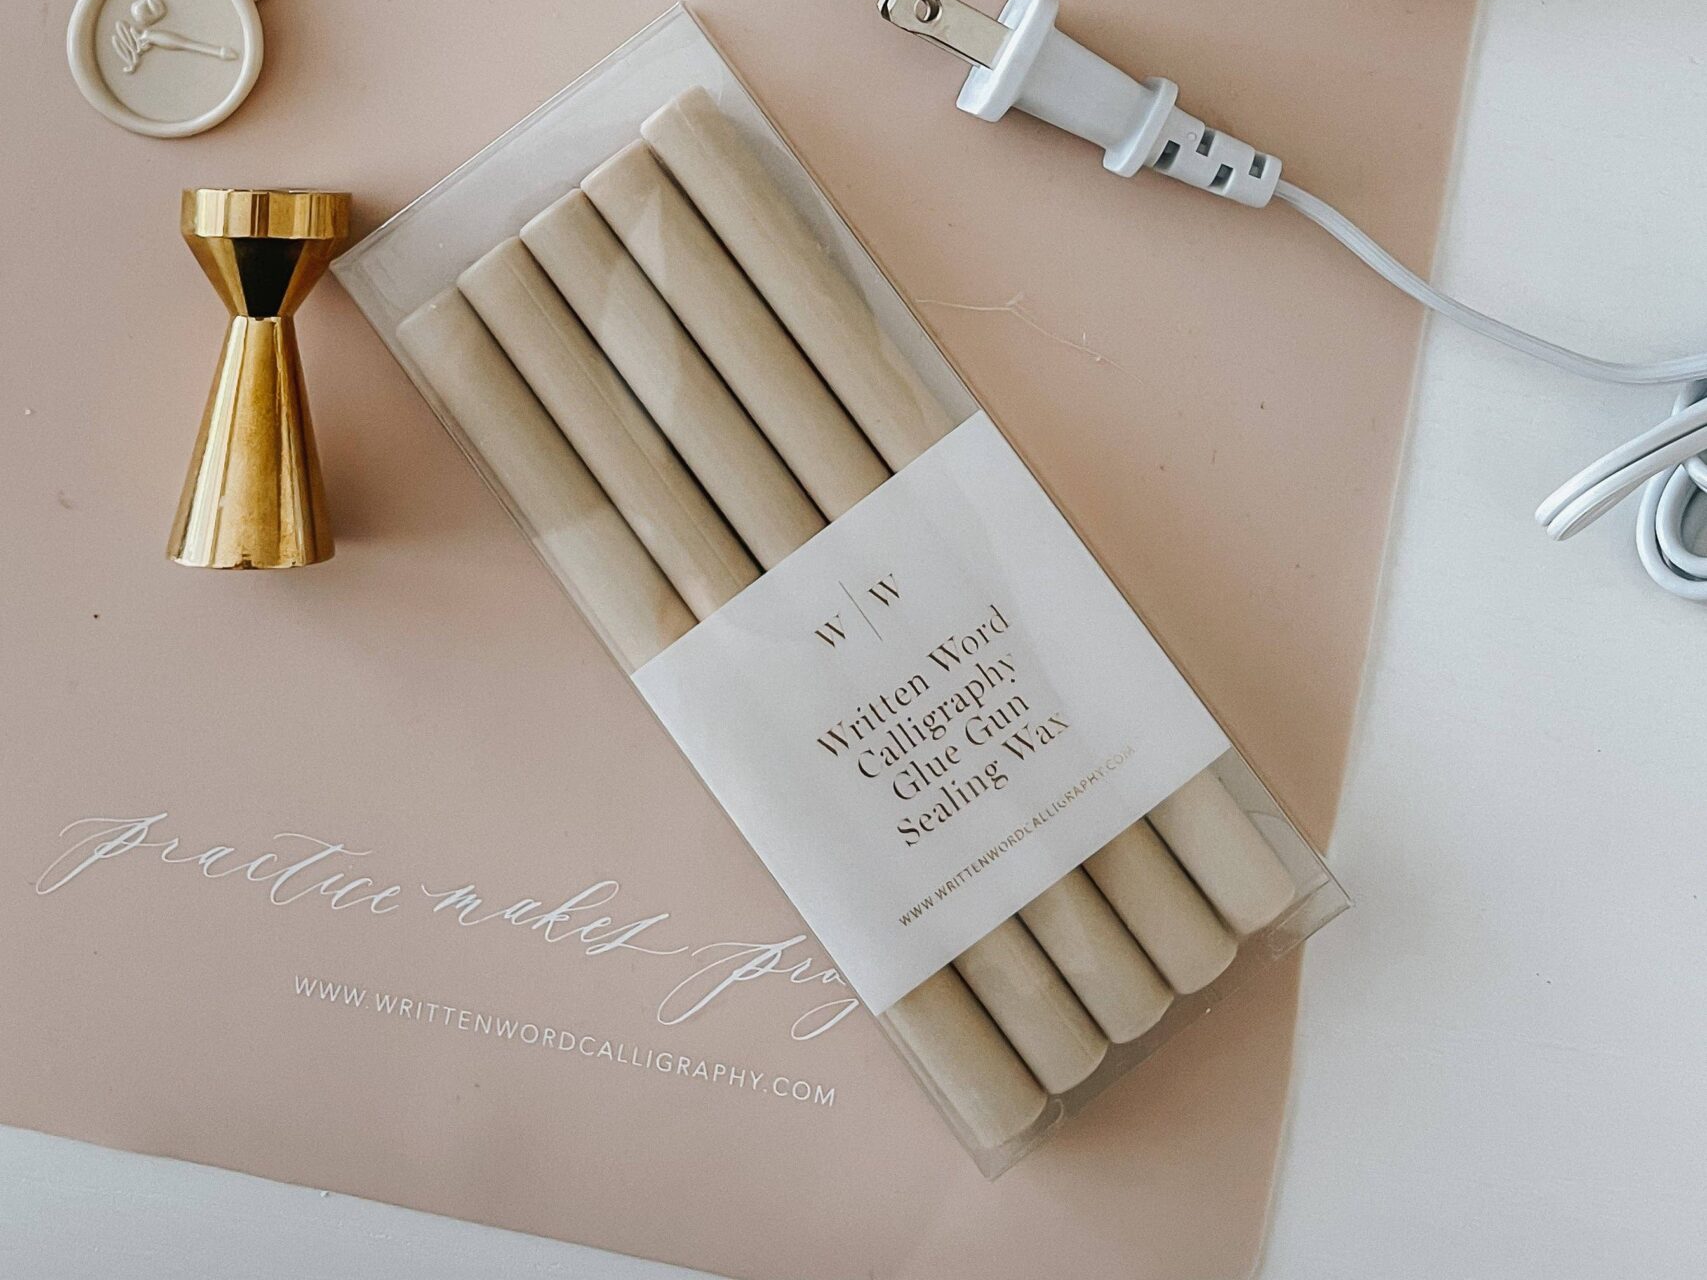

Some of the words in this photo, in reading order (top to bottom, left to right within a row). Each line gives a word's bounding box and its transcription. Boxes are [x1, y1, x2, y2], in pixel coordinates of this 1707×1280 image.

[817, 674, 930, 758] Written
[926, 604, 1011, 672] Word
[857, 653, 1017, 779] Calligraphy
[892, 745, 961, 801] Glue
[964, 695, 1030, 746] Gun
[897, 760, 1009, 847] Sealing
[1002, 712, 1071, 762] Wax
[36, 812, 401, 914] practice
[420, 880, 689, 955] makes
[294, 975, 836, 1107] WWW.WRITTENWORDCALLIGRAPHY.COM
